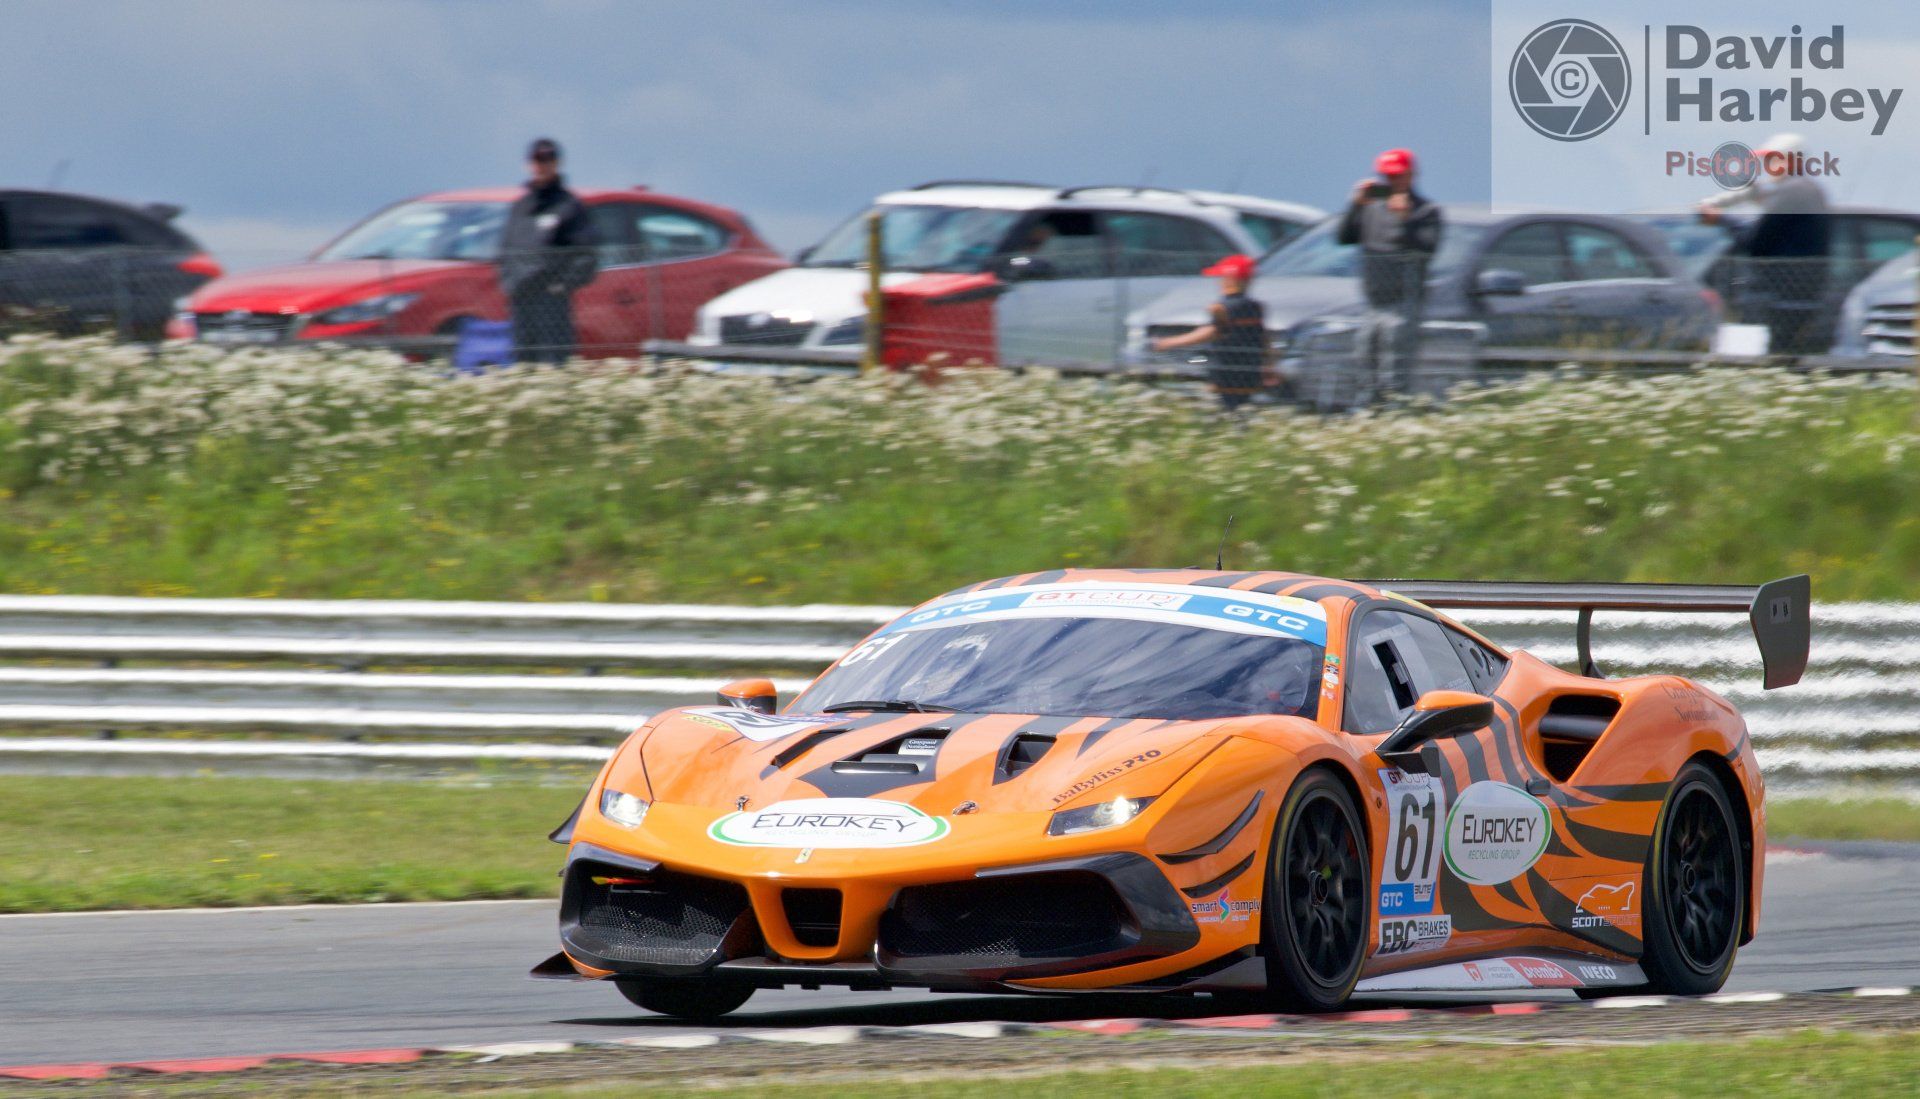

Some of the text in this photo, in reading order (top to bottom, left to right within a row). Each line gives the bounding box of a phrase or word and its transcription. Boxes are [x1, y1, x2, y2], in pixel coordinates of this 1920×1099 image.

[909, 600, 991, 624] GTC
[1222, 604, 1309, 631] GTC
[838, 633, 910, 667] 61
[1121, 749, 1162, 768] PRO
[752, 813, 917, 833] EUROKEY
[1462, 814, 1538, 844] EUROKEY
[1394, 792, 1436, 883] 61
[1191, 901, 1218, 913] smart
[1381, 891, 1404, 908] GTC
[1377, 919, 1449, 955] EBC BRAKES
[1519, 962, 1564, 980] brembo
[1578, 965, 1617, 980] IVECO
